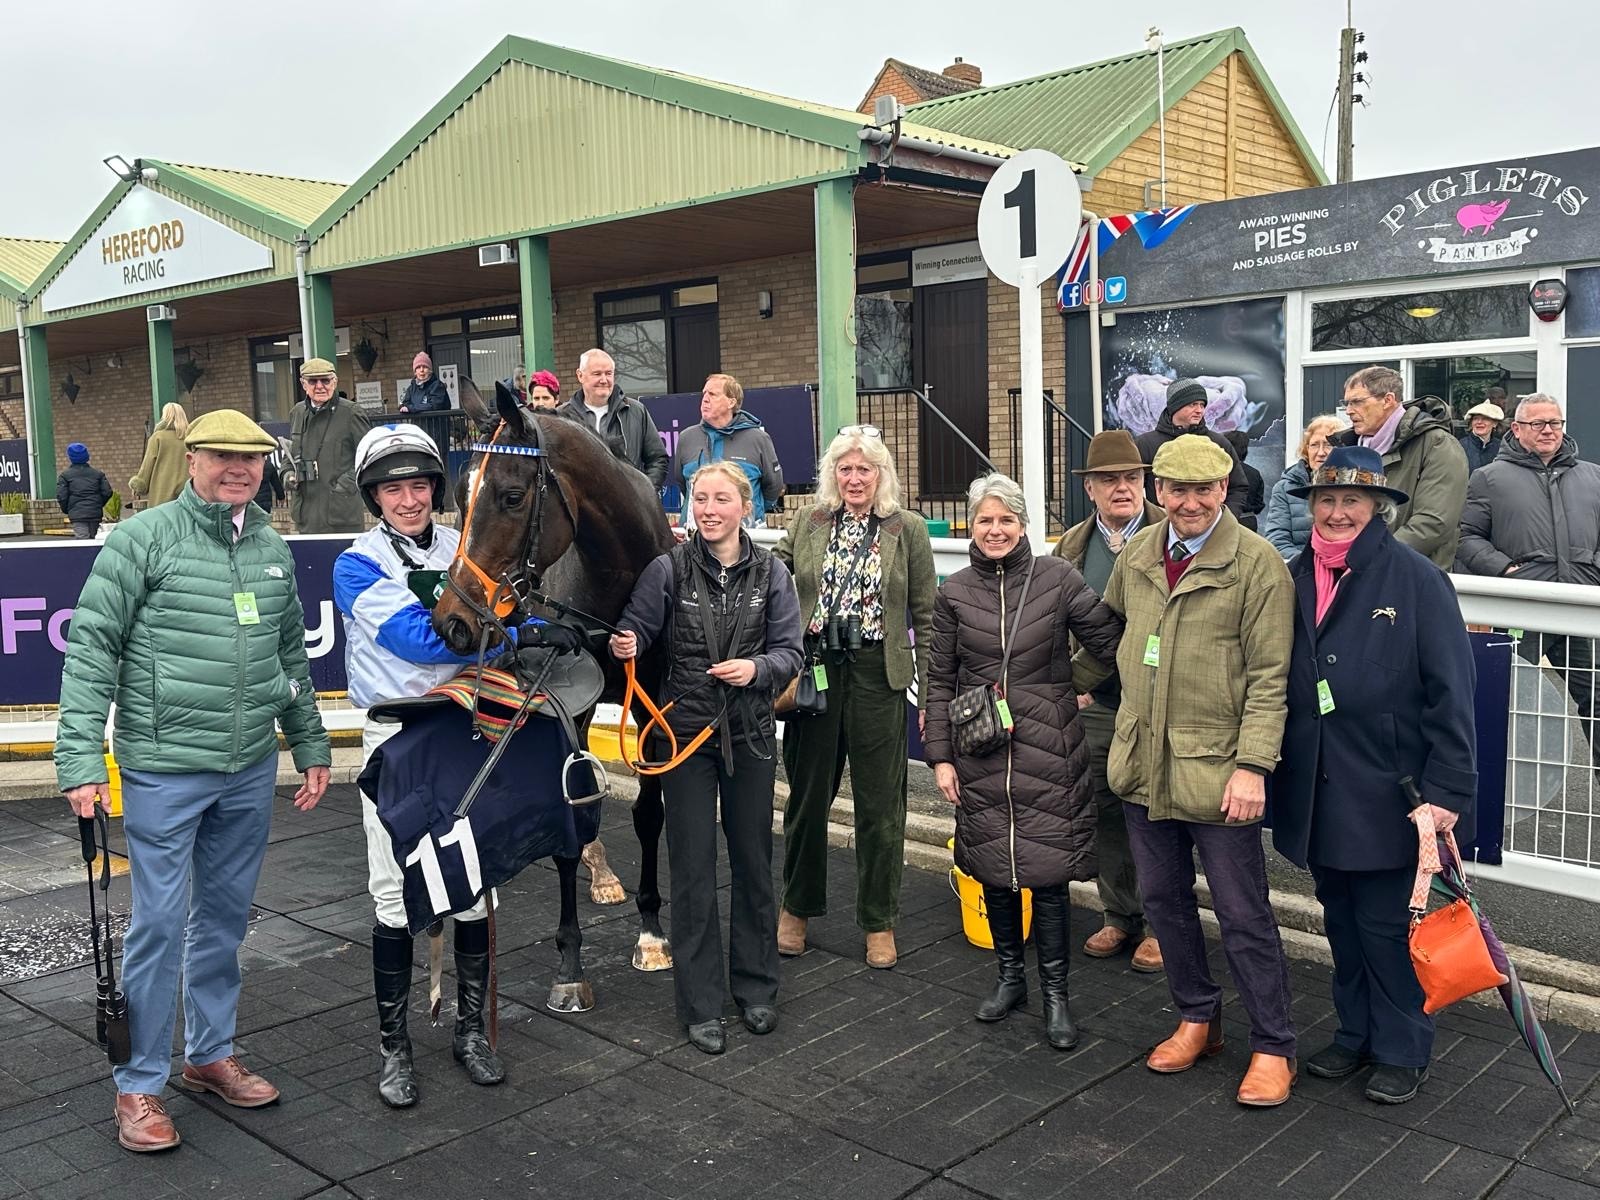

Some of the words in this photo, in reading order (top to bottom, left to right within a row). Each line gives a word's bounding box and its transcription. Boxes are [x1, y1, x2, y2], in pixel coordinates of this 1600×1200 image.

[1004, 169, 1036, 258] 1
[1379, 167, 1589, 237] PIGLETS
[1238, 215, 1279, 230] AWARD
[1280, 208, 1330, 224] WINNING
[102, 219, 185, 266] HEREFORD
[1254, 223, 1307, 252] PIES
[1438, 240, 1519, 260] PANTRY
[914, 260, 941, 271] Winning
[941, 254, 983, 268] Connections
[1232, 259, 1255, 271] AND
[1256, 250, 1306, 267] SAUSAGE
[1307, 244, 1342, 259] ROLLS
[1344, 240, 1360, 253] BY
[123, 258, 165, 285] RACING
[405, 815, 483, 916] 11
